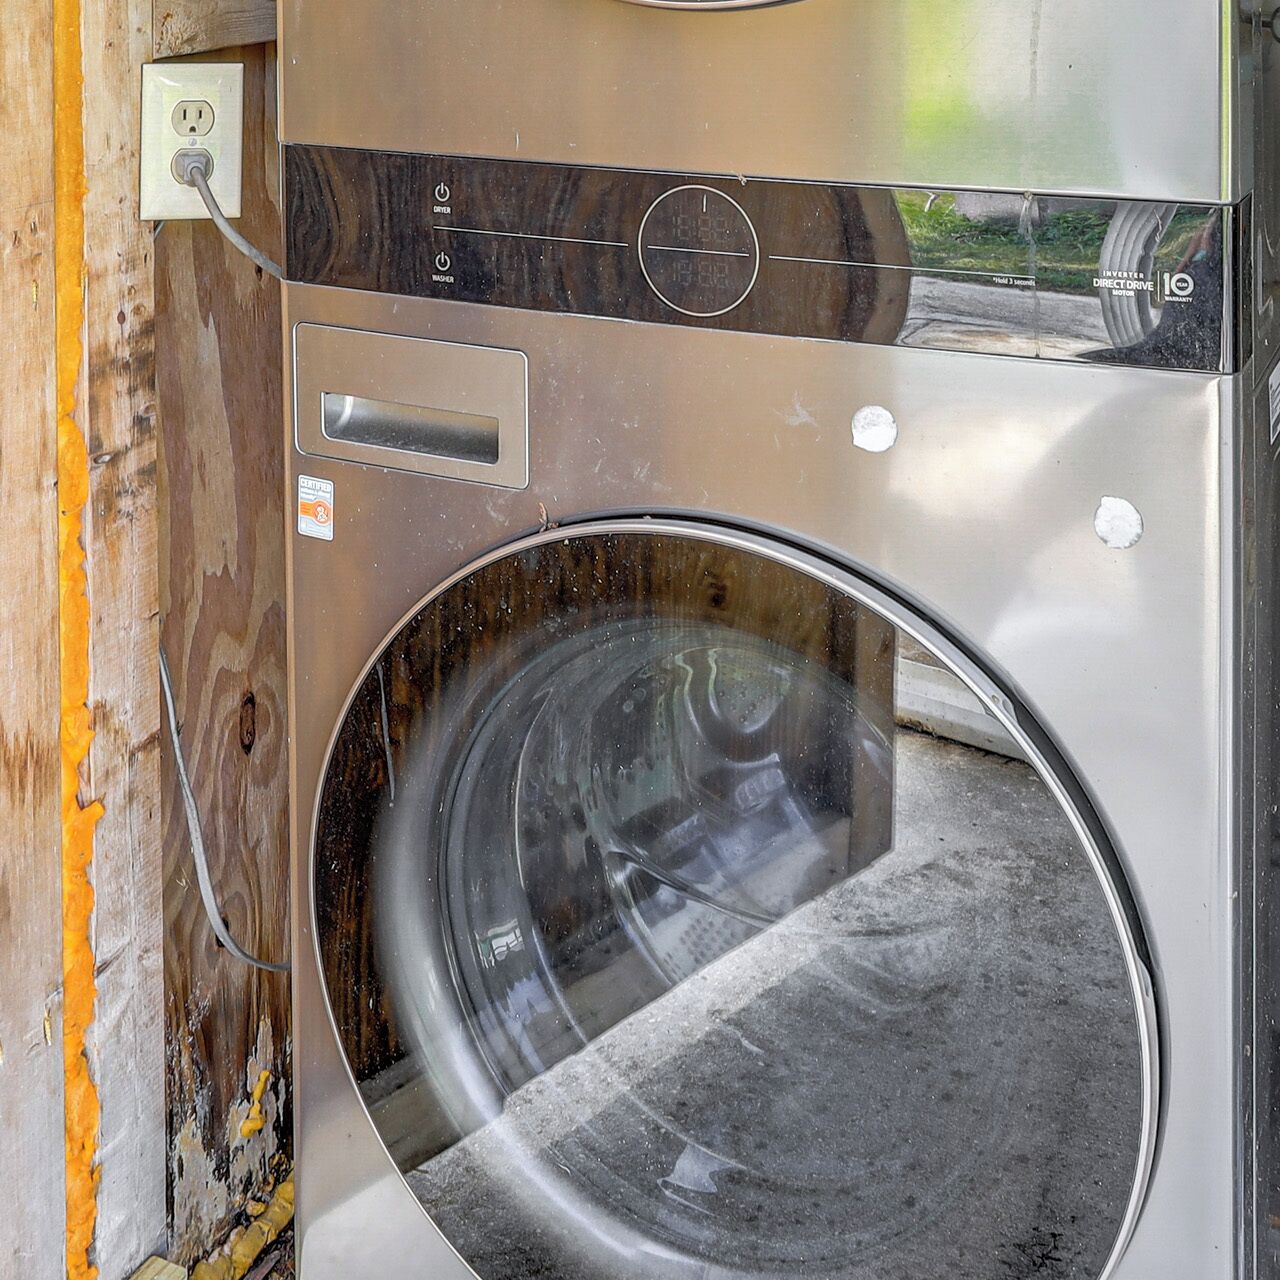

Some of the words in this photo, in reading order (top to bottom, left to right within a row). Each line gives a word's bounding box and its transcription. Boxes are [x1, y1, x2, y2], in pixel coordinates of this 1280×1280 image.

[433, 206, 451, 214] DRYER
[432, 274, 455, 283] WASHER
[1163, 272, 1195, 296] 10
[1093, 278, 1126, 289] DIRECT
[1127, 279, 1154, 291] DRIVE
